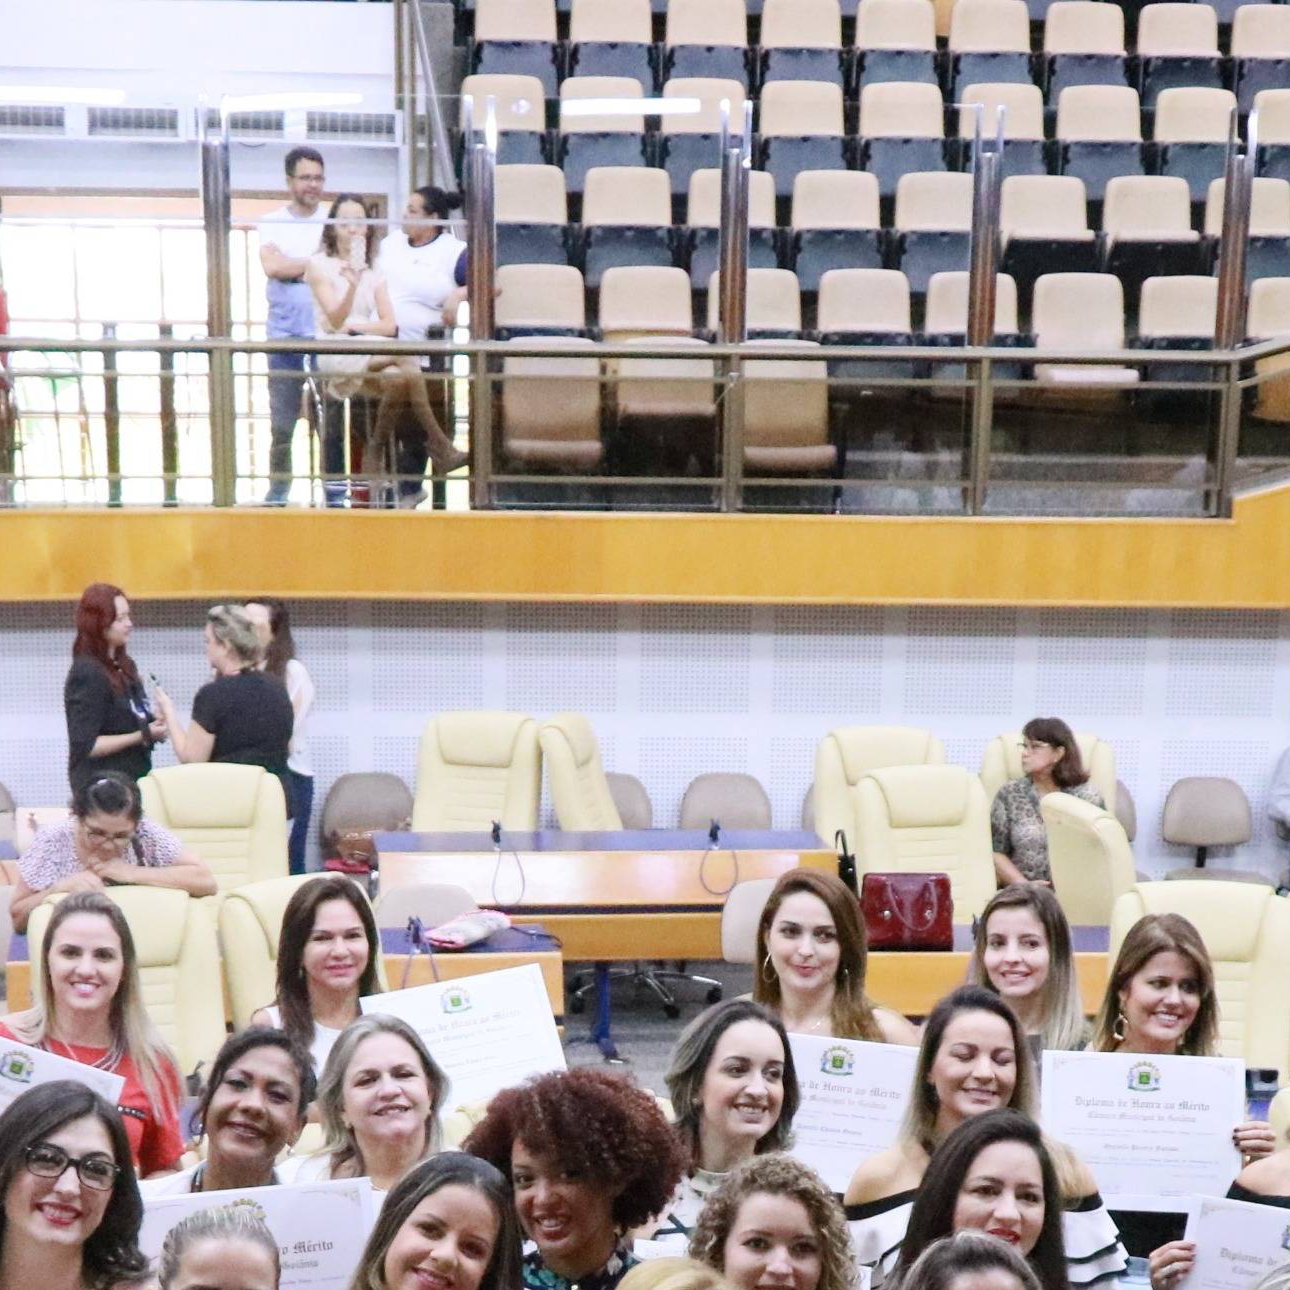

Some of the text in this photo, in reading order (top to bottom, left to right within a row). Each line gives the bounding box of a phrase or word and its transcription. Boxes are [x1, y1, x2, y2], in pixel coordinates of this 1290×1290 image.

[808, 1080, 902, 1100] de Honra ao Mérito
[1074, 1095, 1210, 1111] Diploma de Honra ao Mérito
[292, 1239, 333, 1254] Mérito
[1219, 1247, 1264, 1265] Diploma
